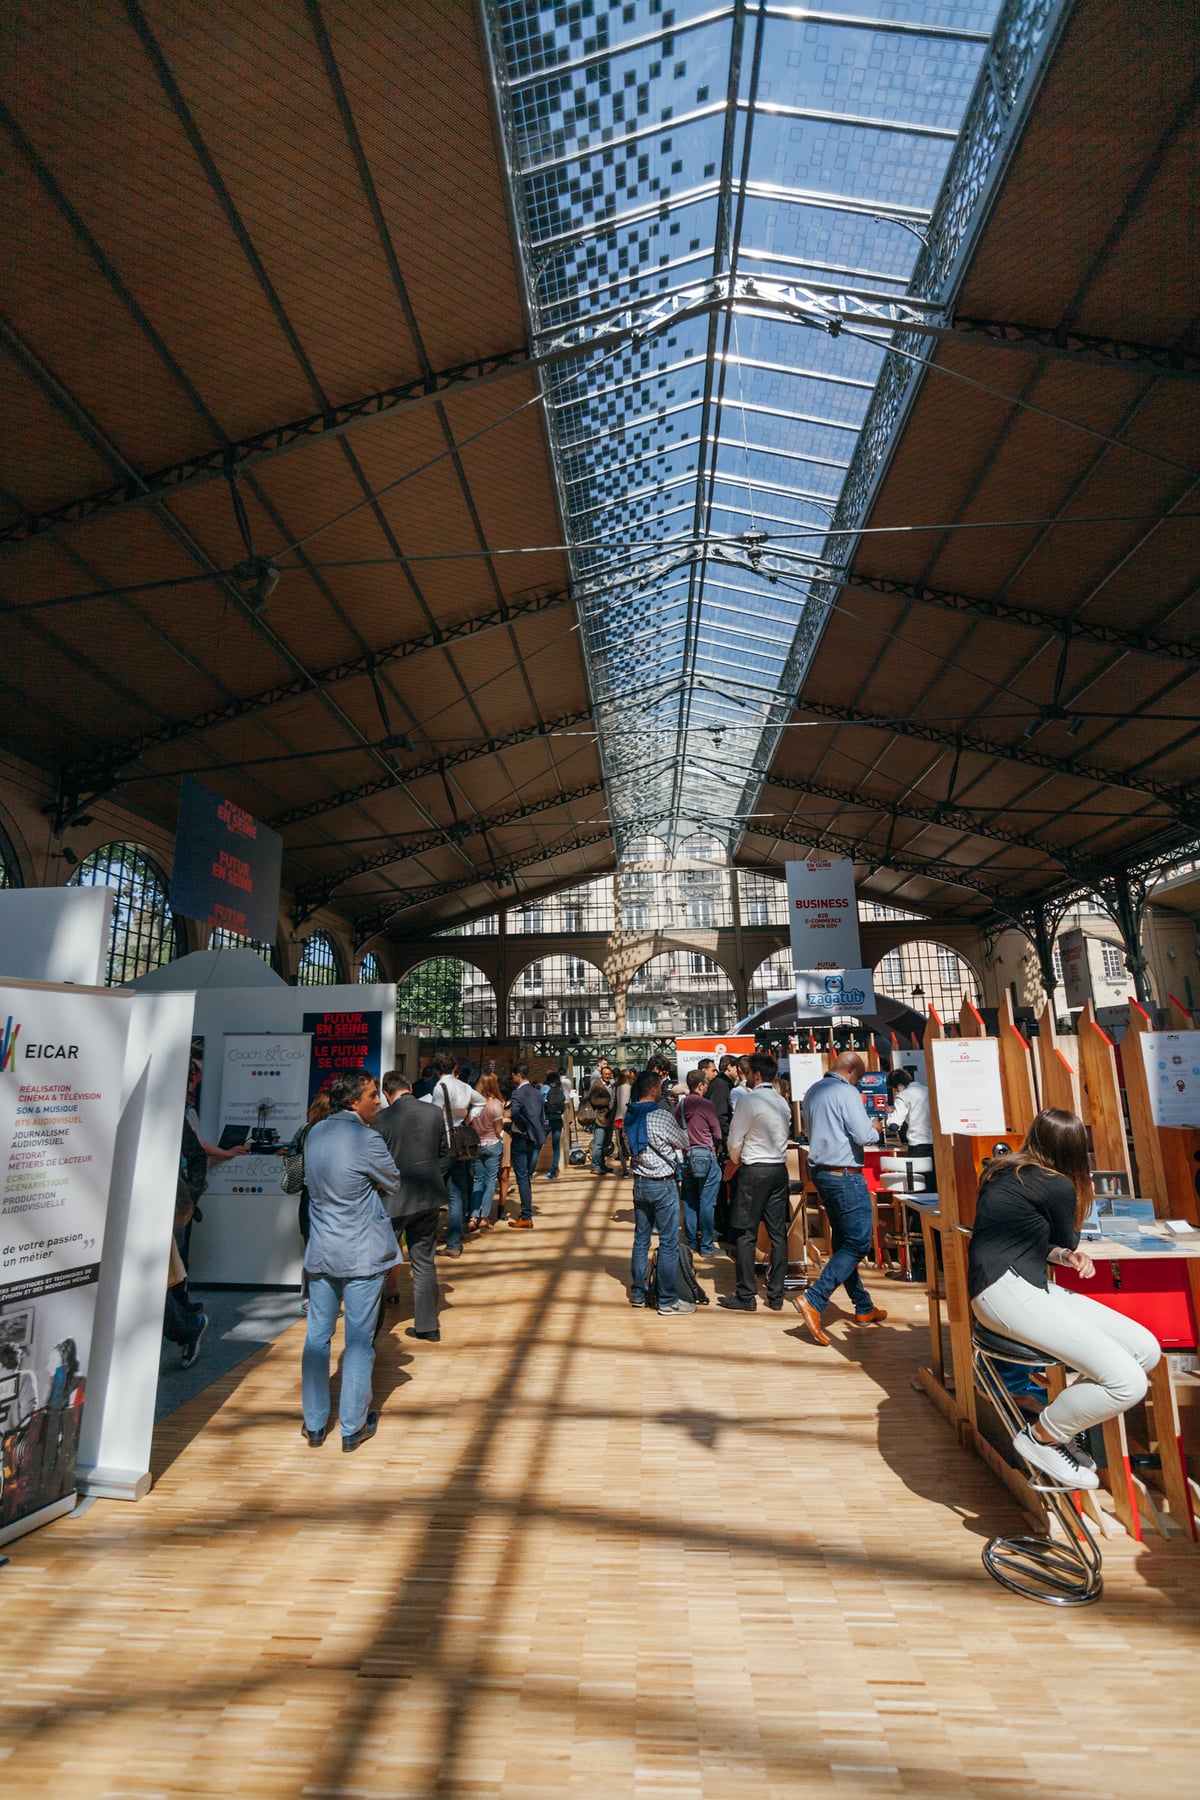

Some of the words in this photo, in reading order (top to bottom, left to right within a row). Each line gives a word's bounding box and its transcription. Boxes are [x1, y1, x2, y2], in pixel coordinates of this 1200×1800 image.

[217, 804, 230, 824] EN
[232, 814, 257, 839] SEINE
[219, 850, 250, 877] FUTUR
[212, 862, 226, 880] EN
[228, 870, 254, 893] SEINE
[796, 899, 849, 909] BUSINESS
[215, 903, 246, 926] FUTUR
[808, 990, 863, 1007] zagatub
[323, 1012, 363, 1024] FUTUR
[316, 1024, 332, 1034] EN
[335, 1023, 368, 1033] SEINE
[25, 1044, 79, 1059] EICAR
[228, 1049, 262, 1061] Coach
[265, 1048, 276, 1061] &
[279, 1049, 305, 1061] Cook
[314, 1046, 328, 1056] LE
[331, 1045, 368, 1056] FUTUR
[318, 1058, 332, 1068] SE
[18, 1093, 50, 1102] CINÉMA
[51, 1093, 57, 1101] &
[59, 1092, 102, 1101] TÉLÉVISION
[43, 1104, 79, 1113] MUSIQUE
[15, 1118, 31, 1127] BTS
[32, 1116, 83, 1126] AUDIOVISUEL
[13, 1128, 70, 1140] JOURNALISME
[11, 1137, 65, 1149] AUDIOVISUEL
[9, 1151, 47, 1161] ACTORAT
[46, 1158, 57, 1167] DE
[59, 1154, 93, 1166] L'ACTEUR
[6, 1171, 48, 1183] ÉCRITURE
[2, 1191, 56, 1206] PRODUCTION
[1, 1198, 66, 1215] AUDIOVISUELLE
[2, 1245, 16, 1255] de
[18, 1240, 45, 1252] votre
[47, 1233, 83, 1249] passion
[3, 1258, 16, 1267] un
[19, 1250, 54, 1264] métier
[11, 1280, 44, 1292] ARTISTIQUES
[54, 1270, 84, 1282] TECHNIQUES
[45, 1279, 71, 1291] NOUVEAUX
